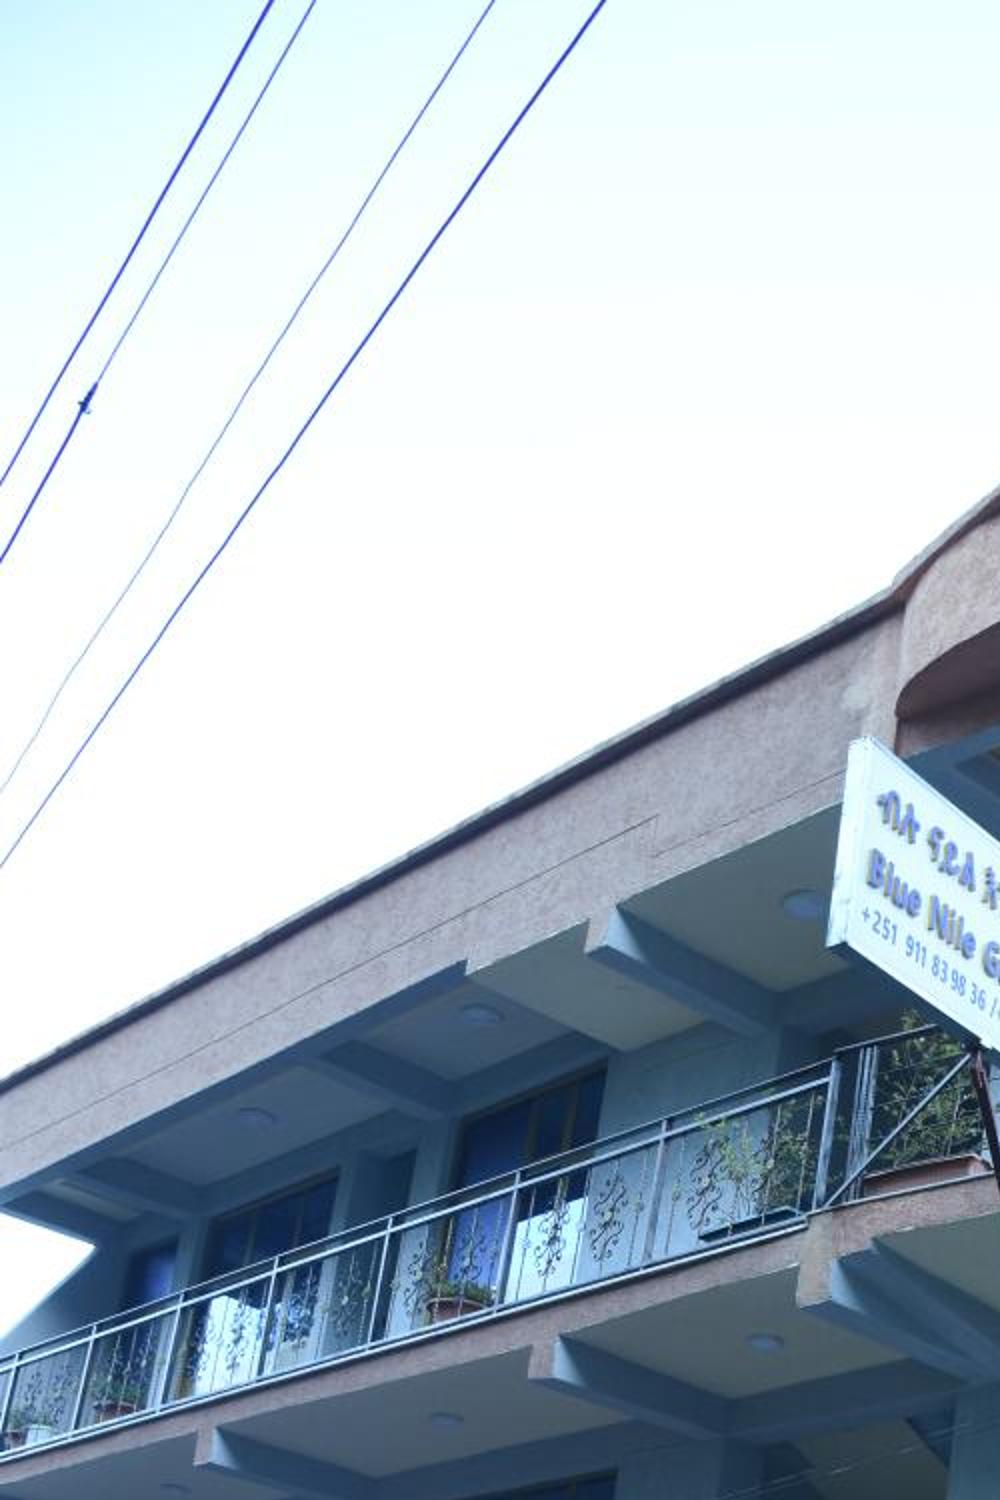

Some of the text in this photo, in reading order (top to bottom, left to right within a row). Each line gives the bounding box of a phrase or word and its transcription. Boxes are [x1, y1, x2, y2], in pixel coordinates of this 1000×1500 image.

[862, 906, 897, 944] +251
[906, 934, 926, 968] 911
[866, 848, 922, 918] Blue
[927, 894, 976, 960] Nile
